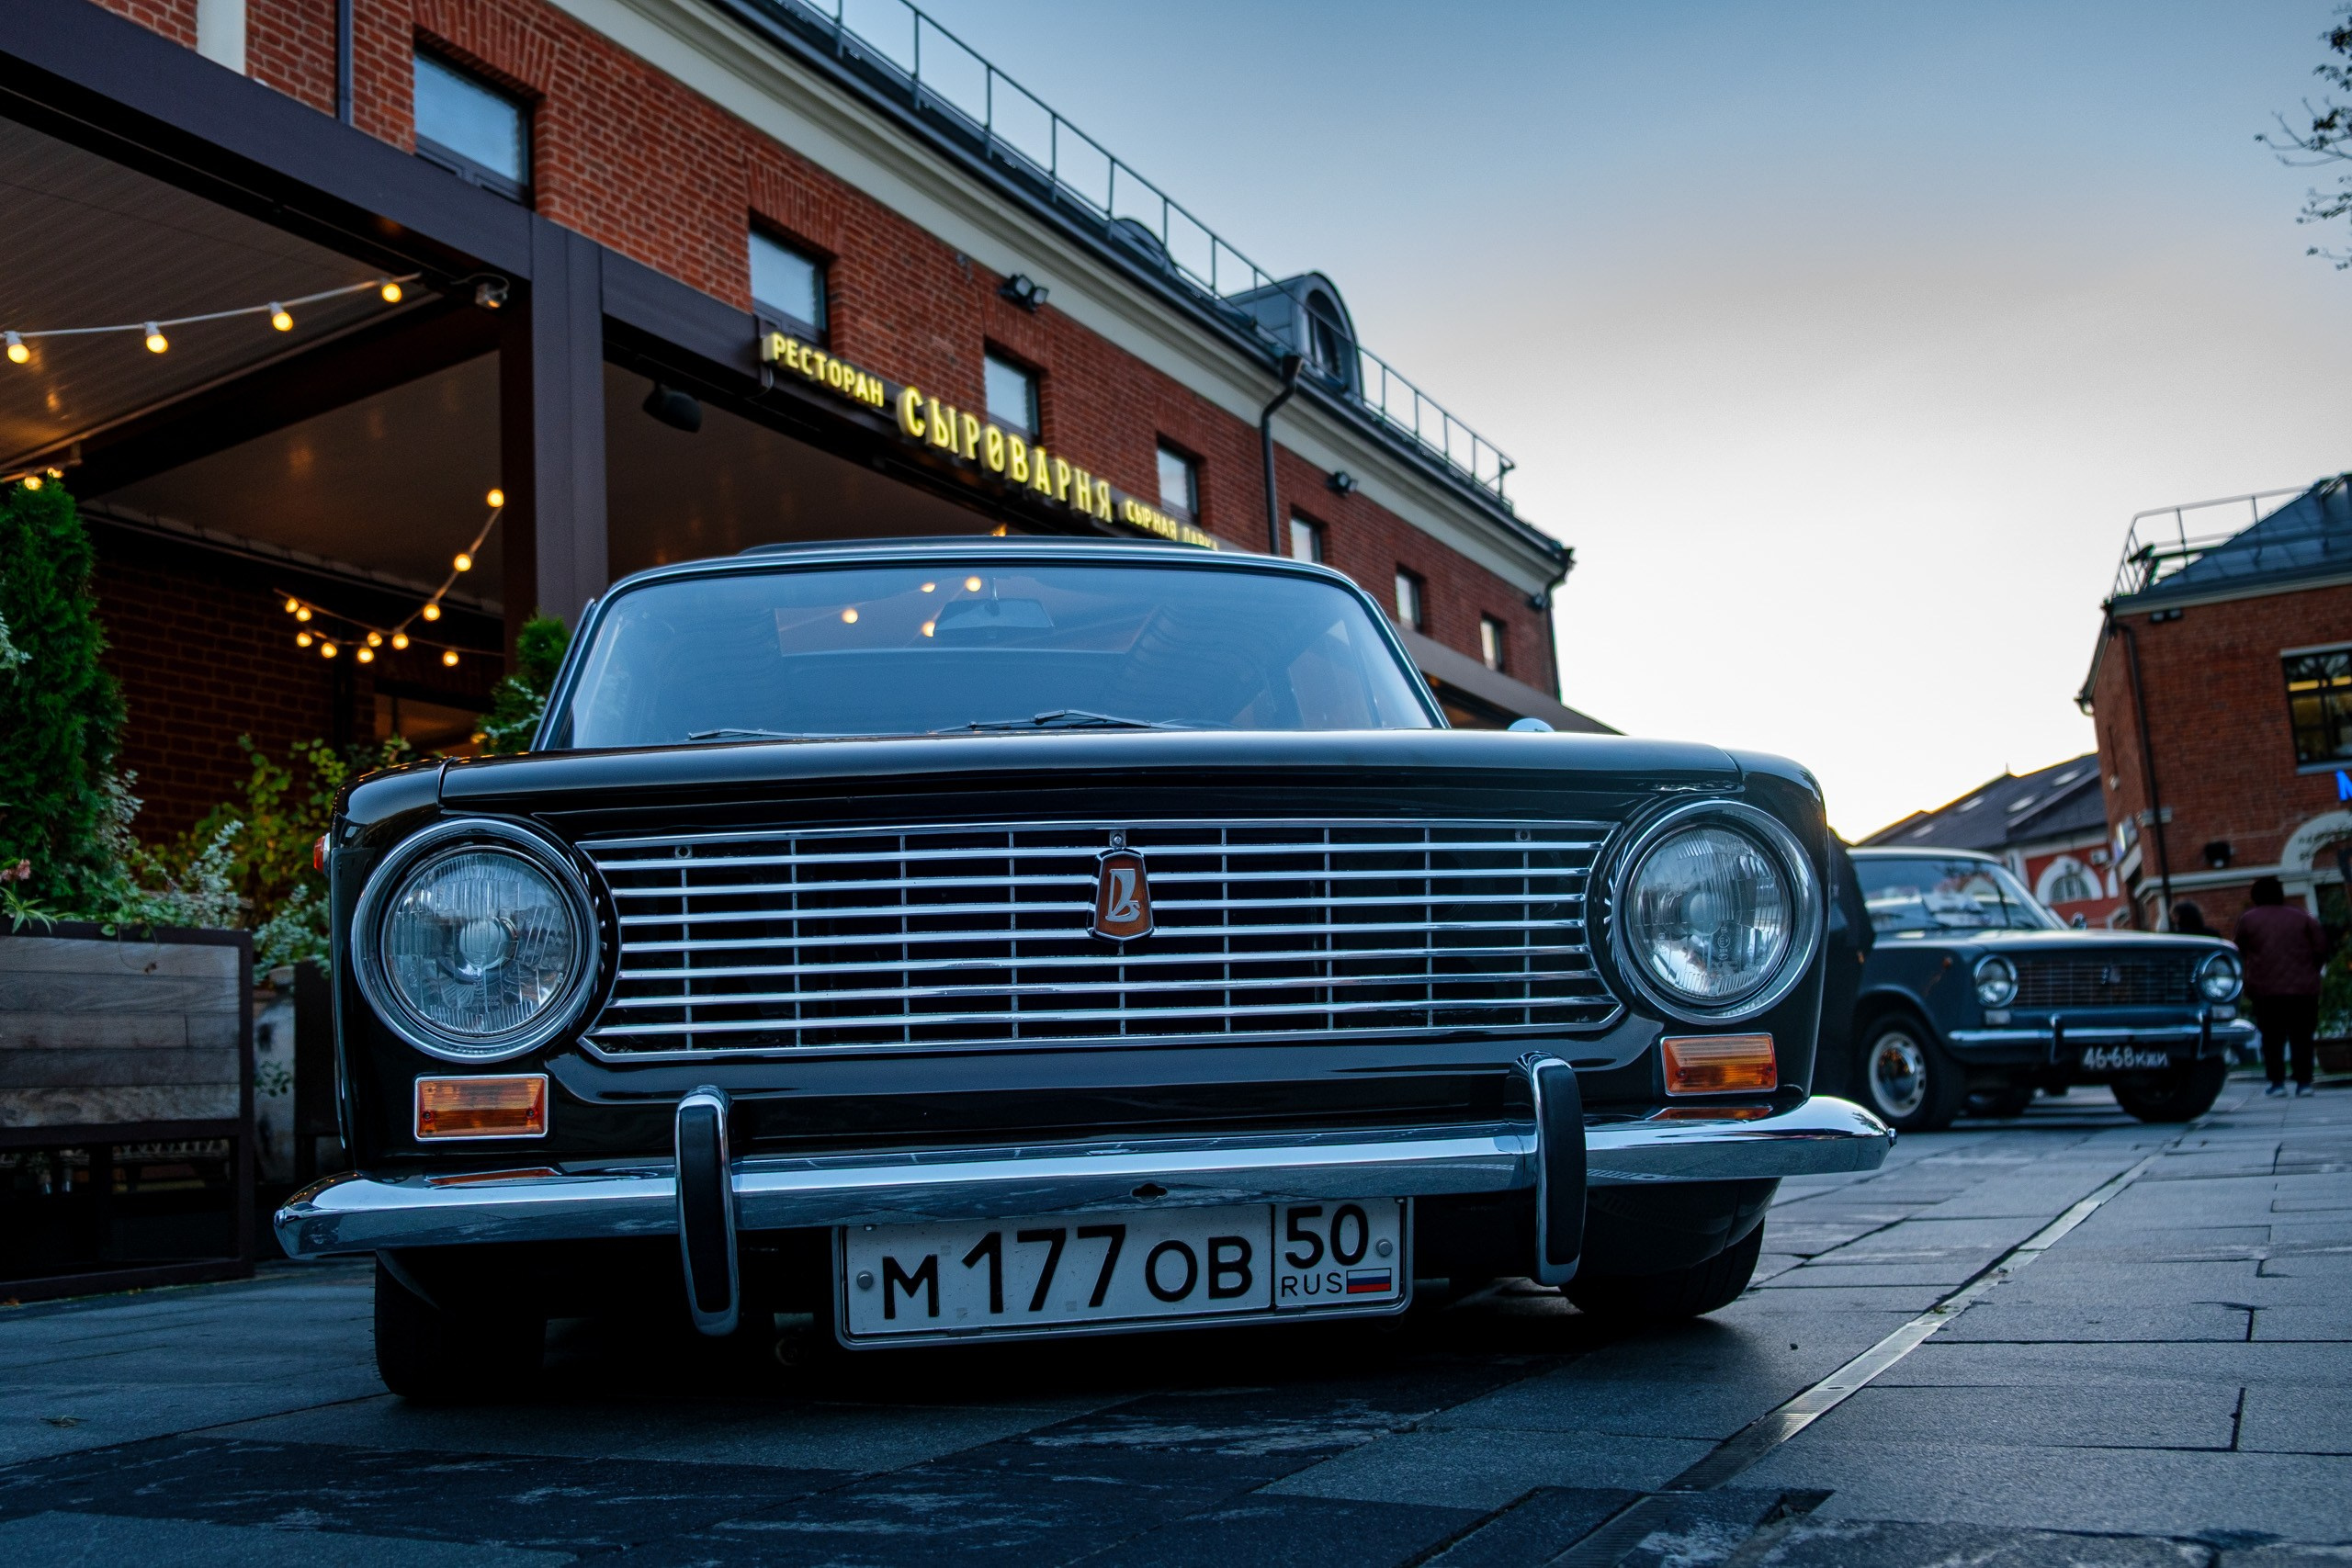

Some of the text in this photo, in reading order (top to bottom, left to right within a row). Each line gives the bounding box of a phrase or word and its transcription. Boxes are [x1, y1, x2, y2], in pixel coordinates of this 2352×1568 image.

[770, 332, 885, 408] РЕСТОРАН
[898, 386, 1114, 525] СЫРОВАРНЯ
[1124, 499, 1179, 542] СЫРНАЯ
[1284, 1203, 1370, 1269] 50
[1281, 1271, 1344, 1298] RUS
